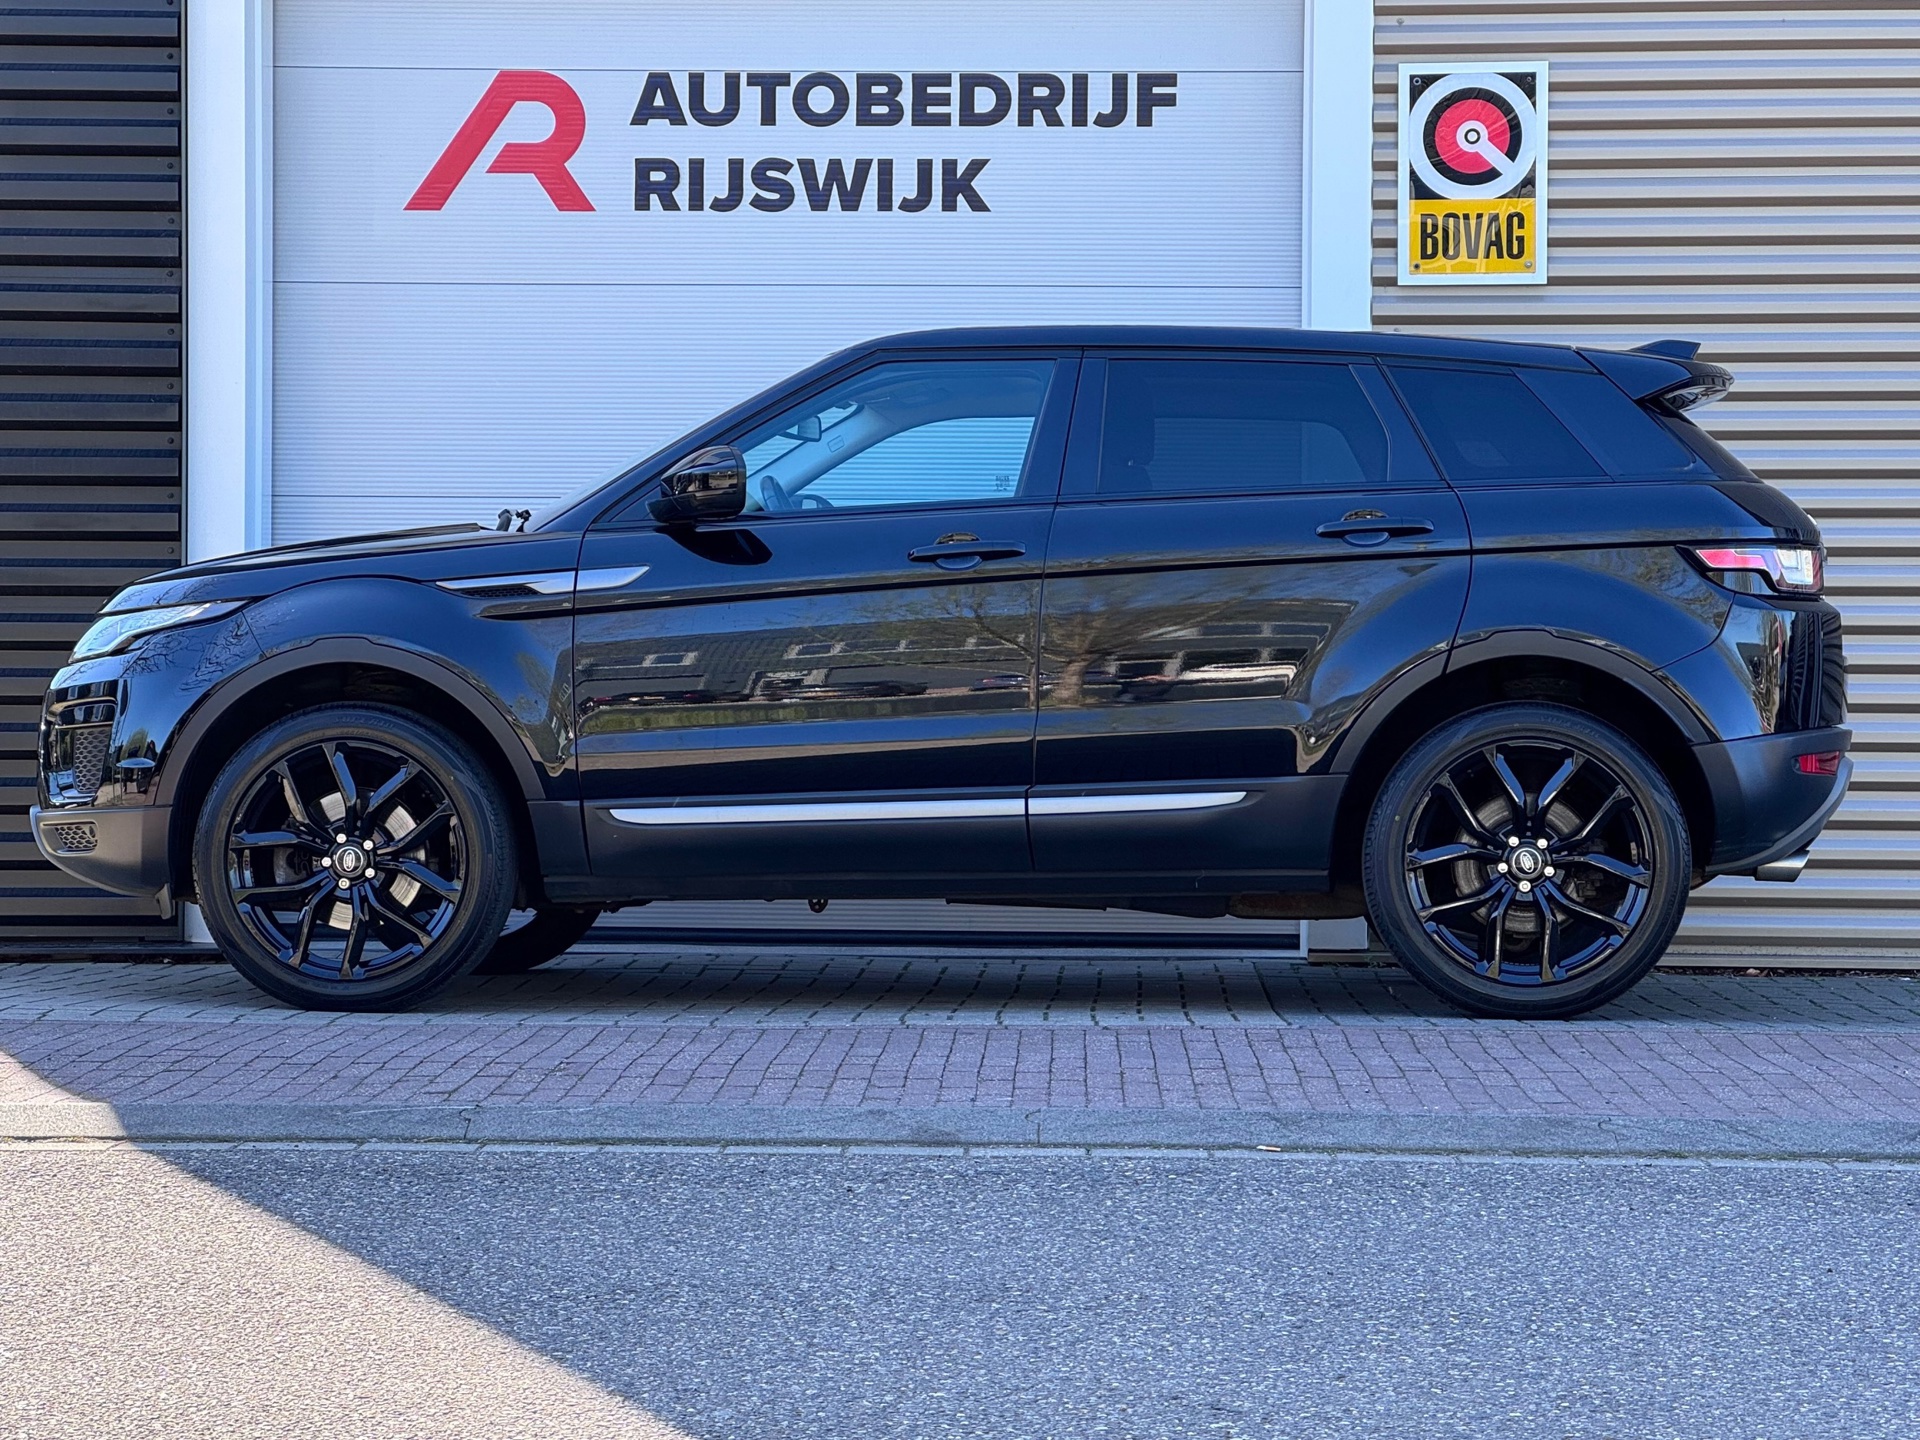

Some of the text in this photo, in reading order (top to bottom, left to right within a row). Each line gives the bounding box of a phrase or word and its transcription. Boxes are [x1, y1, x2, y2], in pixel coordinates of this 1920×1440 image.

[630, 71, 1178, 128] AUTOBEDRIJF
[633, 158, 991, 213] RIJSWIJK
[1420, 212, 1525, 260] BOVAG
